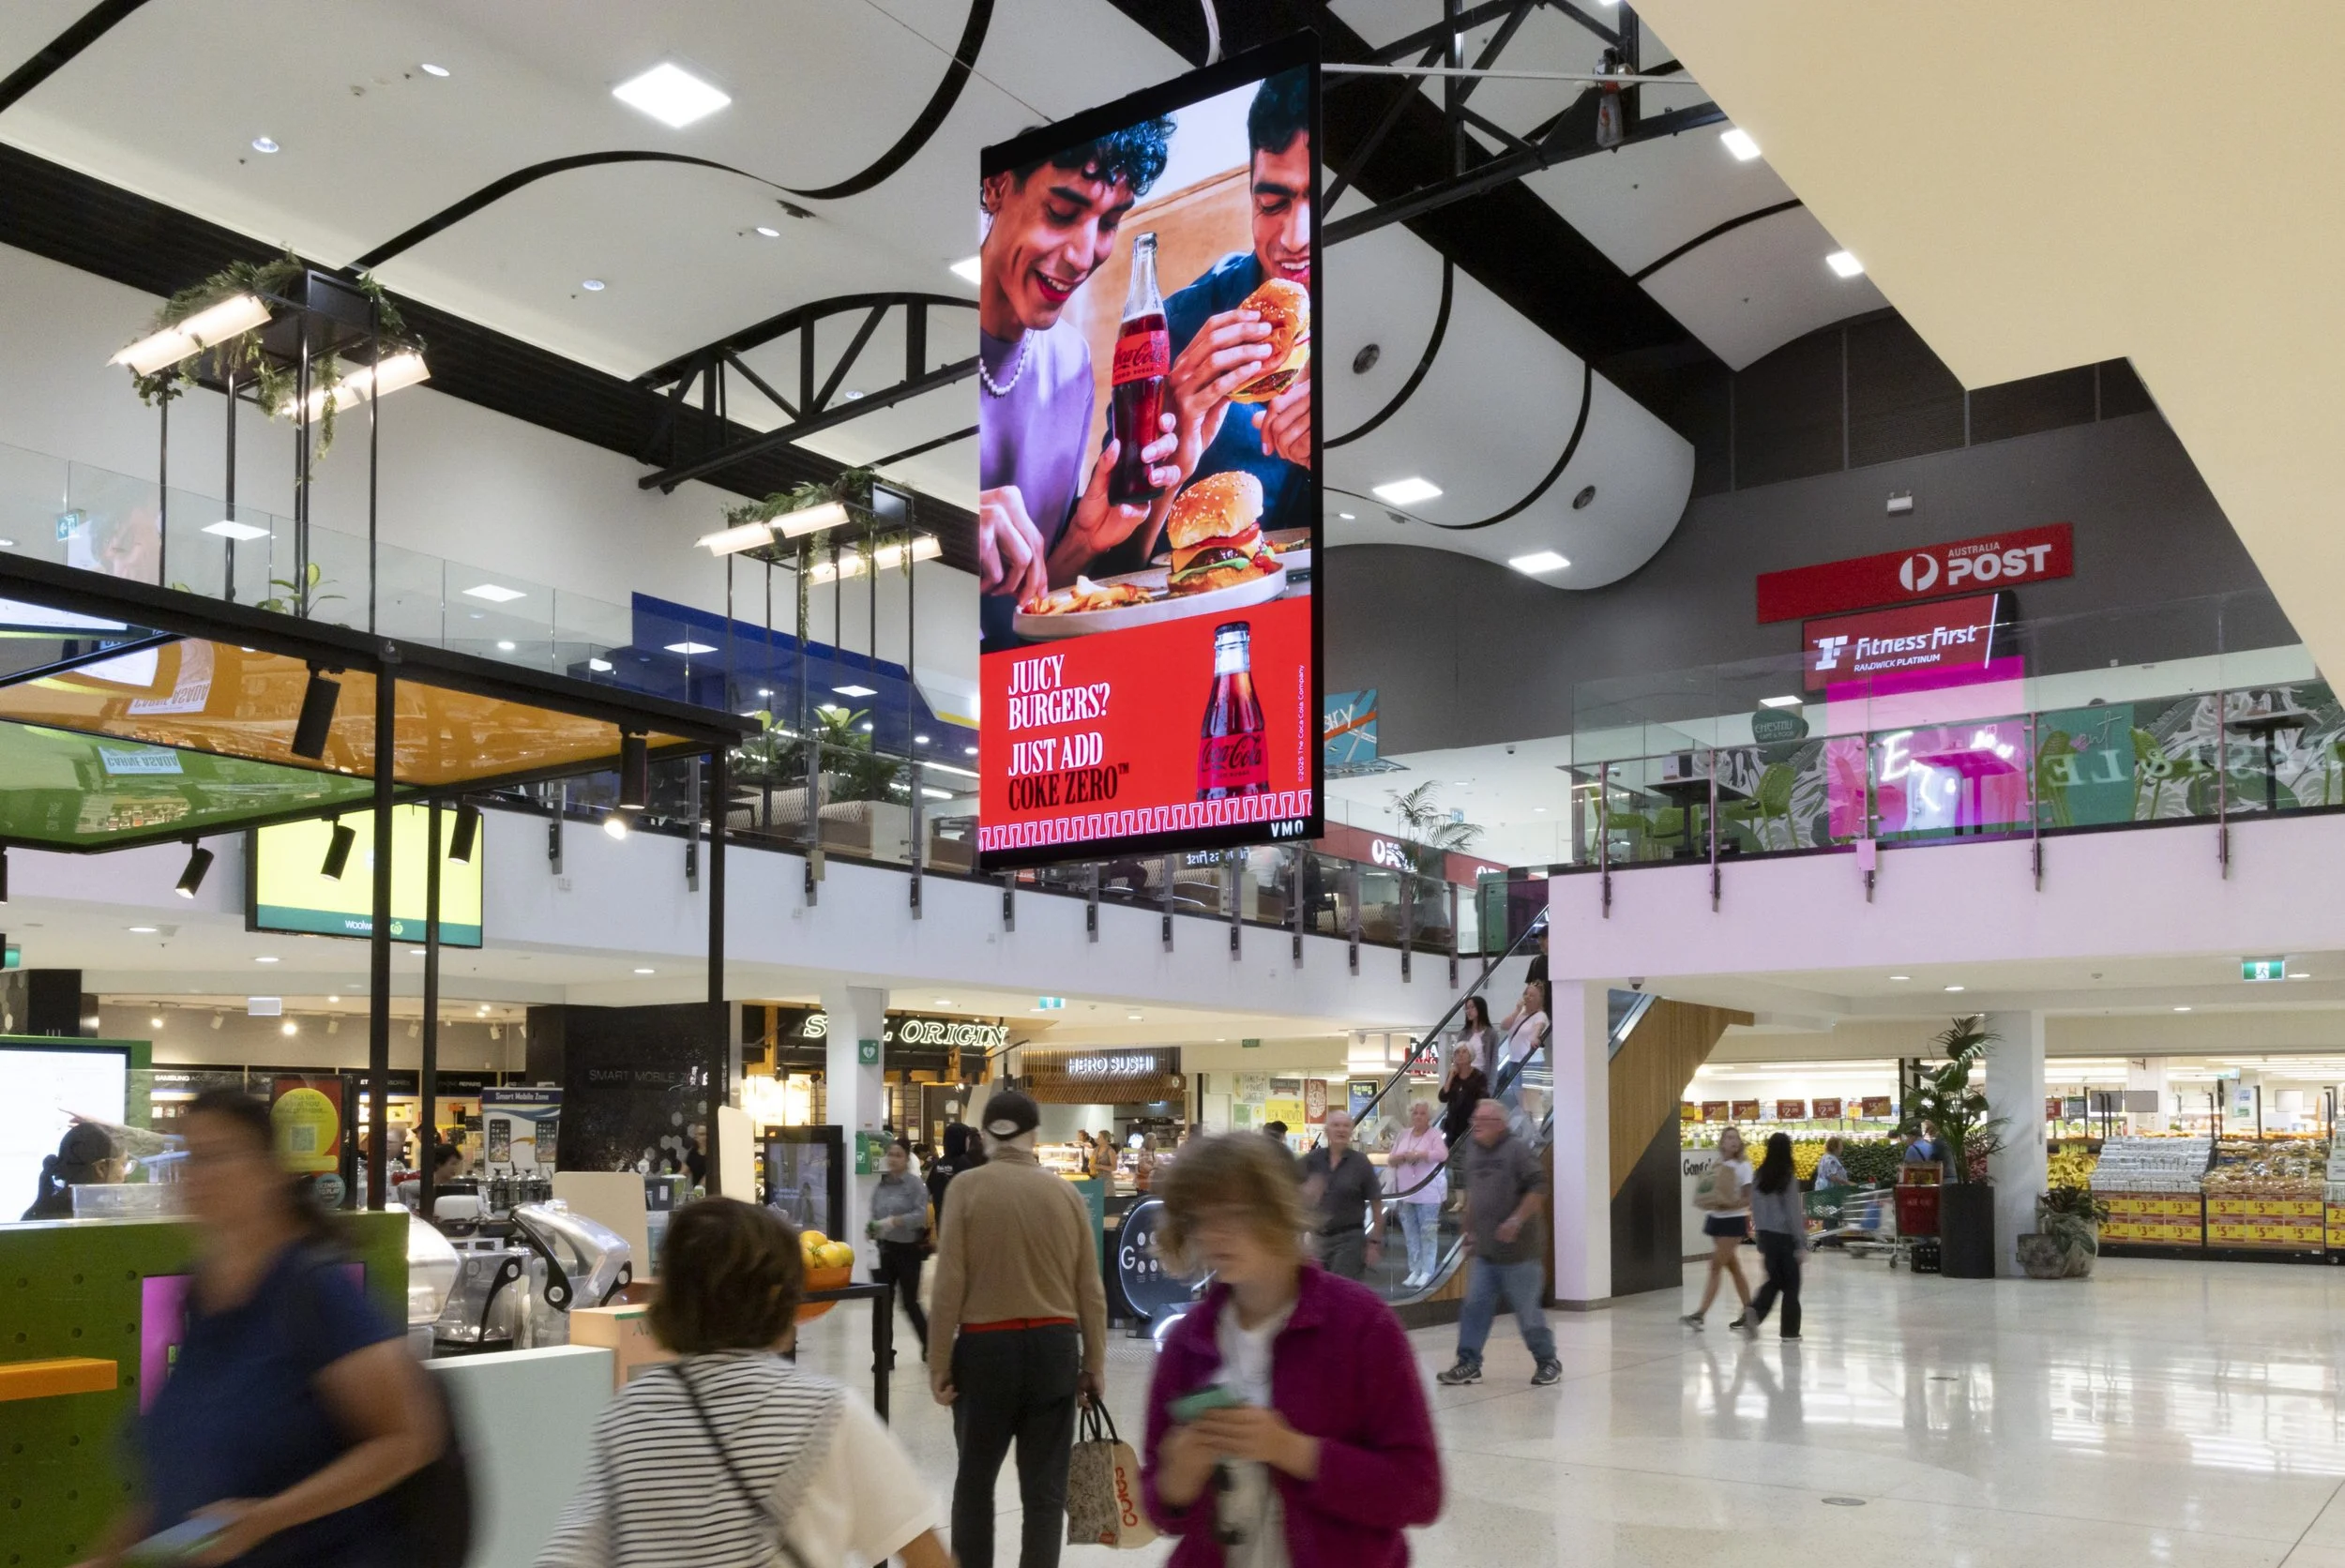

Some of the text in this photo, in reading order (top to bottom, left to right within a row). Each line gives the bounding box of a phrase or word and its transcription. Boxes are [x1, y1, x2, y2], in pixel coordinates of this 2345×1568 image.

[1948, 542, 2001, 557] AUSTRALIA
[1948, 544, 2051, 585] POST
[1855, 625, 1977, 660] Fitness First
[1007, 654, 1066, 696] JUICY
[1897, 654, 1940, 667] PLATINUM
[1008, 682, 1111, 731] BURGERS?
[1007, 731, 1103, 776] JUST ADD
[1008, 773, 1060, 811] COKE
[1271, 820, 1304, 837] VMO
[900, 1020, 1008, 1047] ORIGIN
[589, 1069, 628, 1081] SMART
[634, 1071, 675, 1082] MOBILE
[1068, 1056, 1154, 1073] HERO SUSHI
